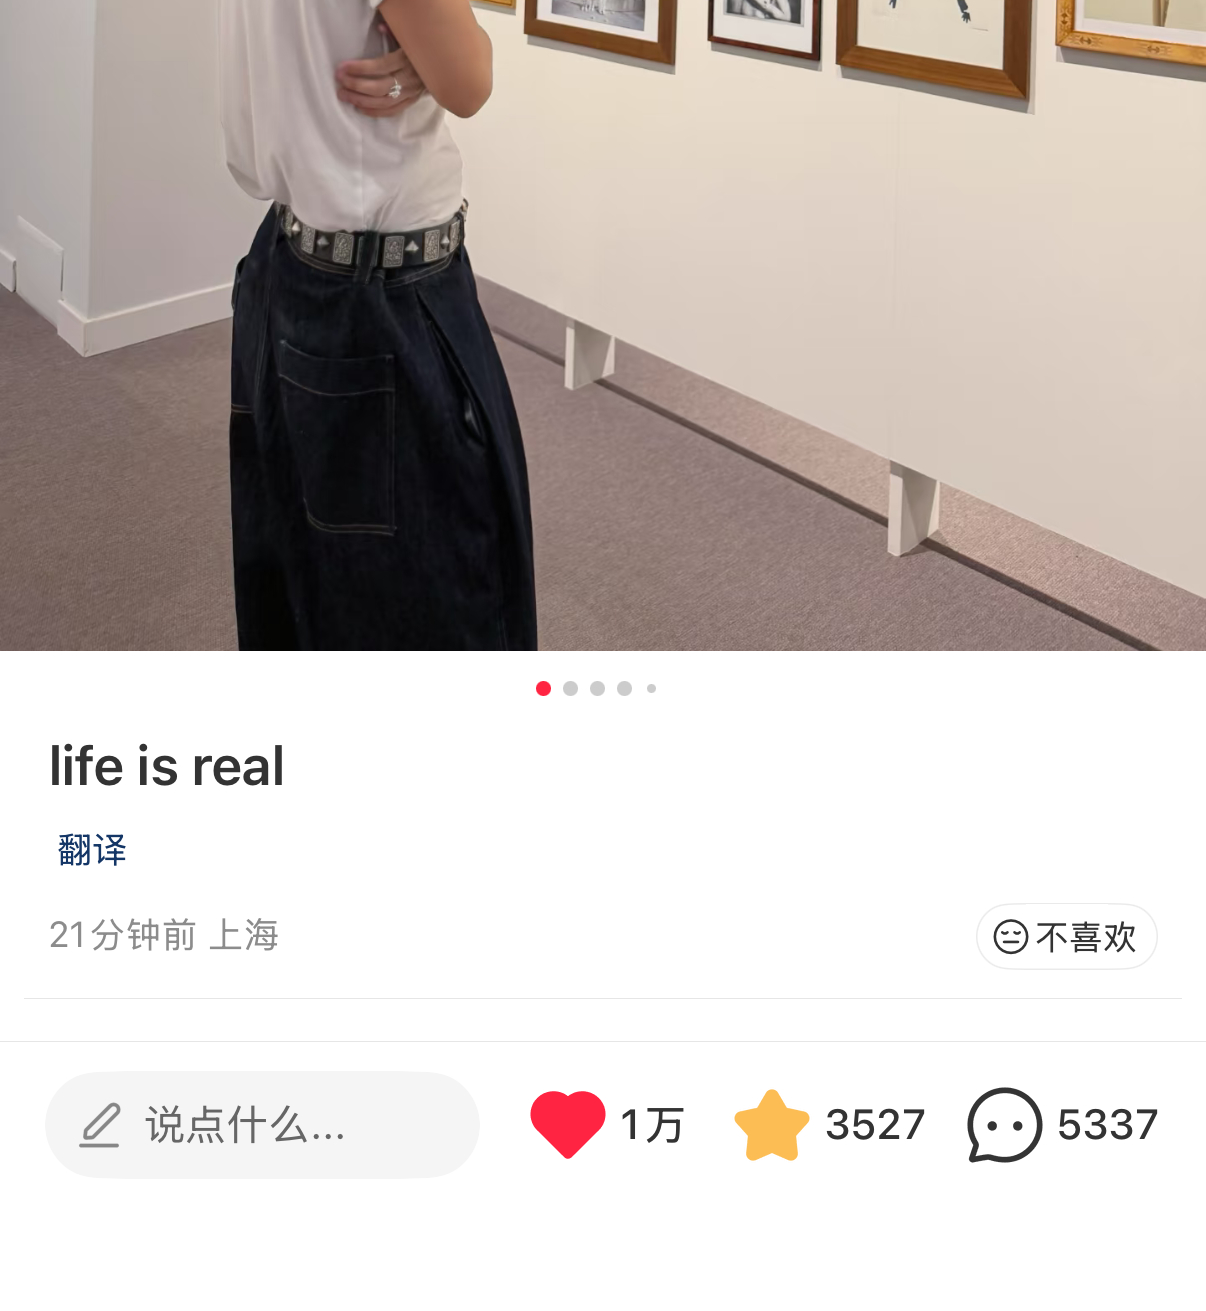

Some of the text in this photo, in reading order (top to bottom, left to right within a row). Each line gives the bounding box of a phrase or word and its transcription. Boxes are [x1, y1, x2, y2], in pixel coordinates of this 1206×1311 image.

[52, 744, 282, 786] life is real
[58, 833, 126, 866] 翻译
[51, 918, 278, 951] 21分钟前 上海
[1037, 921, 1135, 953] 不喜欢
[622, 1108, 684, 1143] 1万
[827, 1109, 924, 1140] 3527
[1059, 1109, 1157, 1140] 5337
